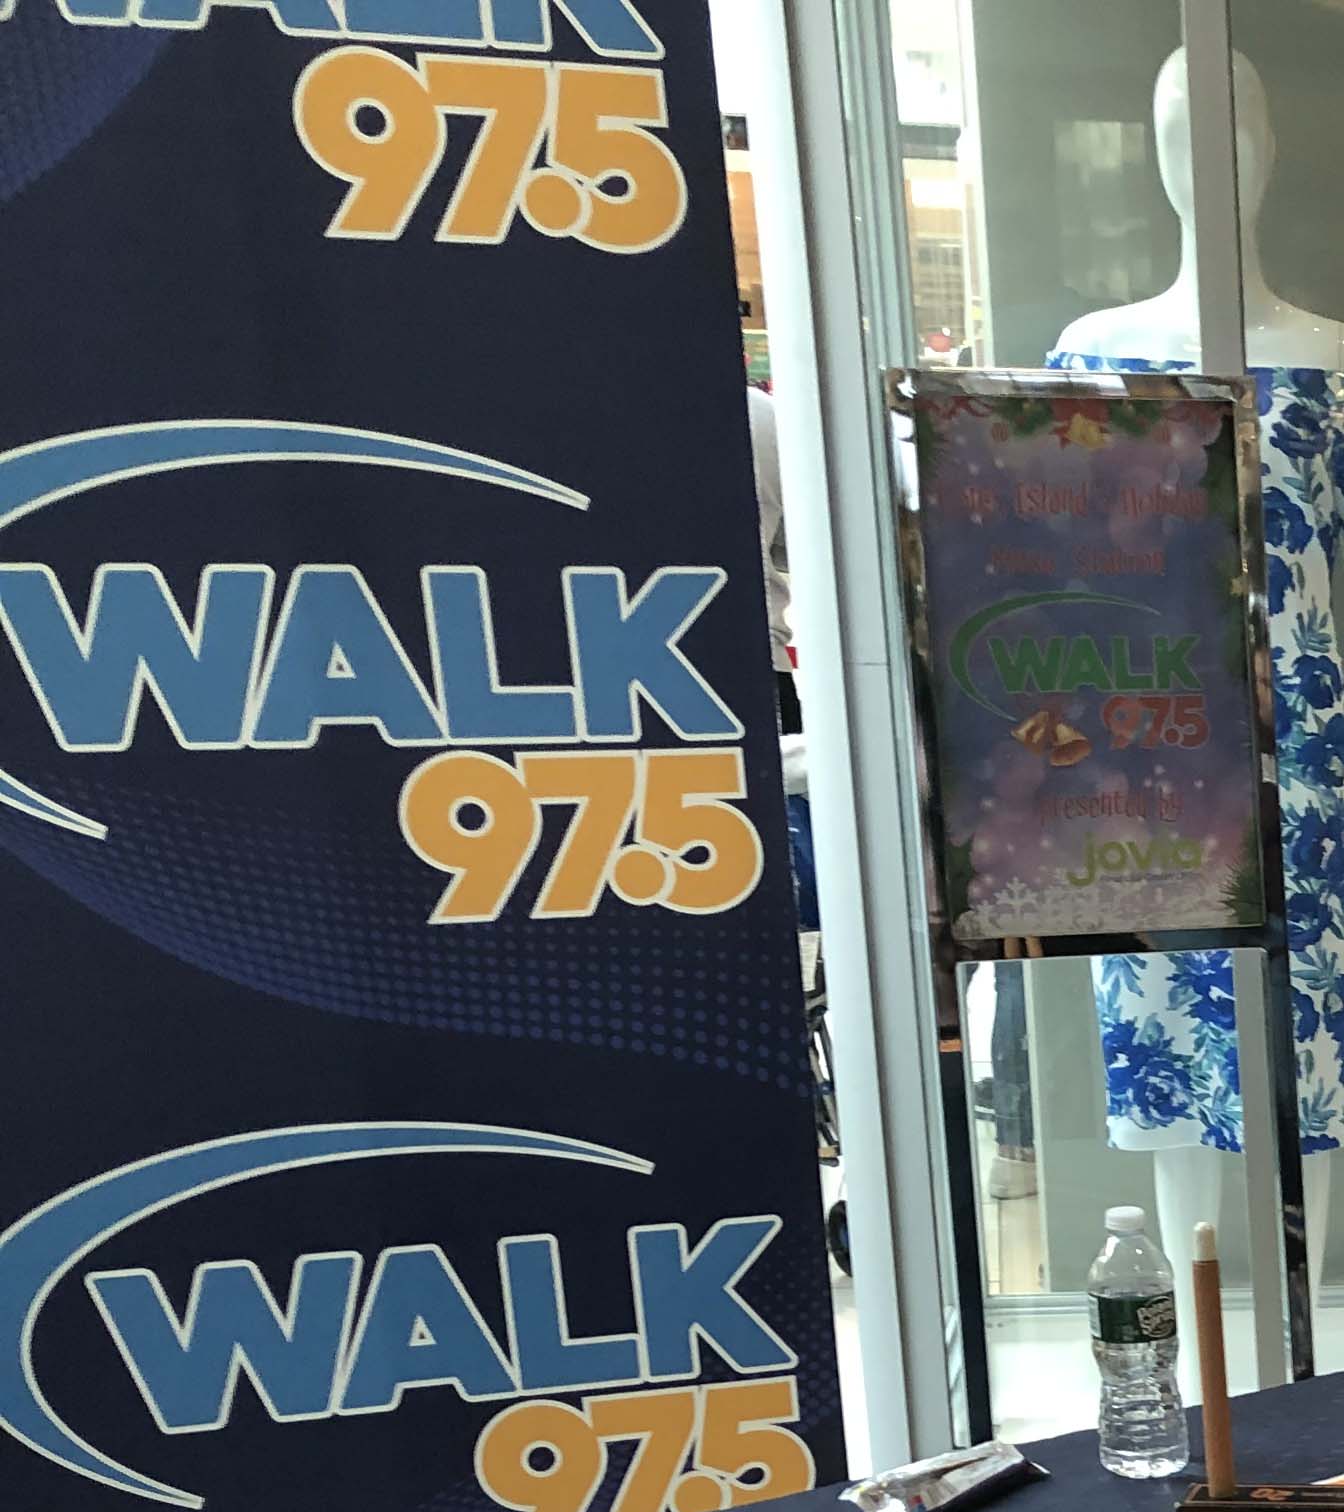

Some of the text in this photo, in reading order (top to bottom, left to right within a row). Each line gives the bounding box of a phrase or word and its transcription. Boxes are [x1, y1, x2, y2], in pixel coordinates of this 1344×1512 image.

[292, 45, 688, 254] 97.5
[0, 563, 745, 753] WALK
[987, 634, 1206, 693] WALK
[1101, 695, 1211, 750] 97.5
[400, 748, 764, 925] 97.5
[84, 1215, 798, 1435] WALK
